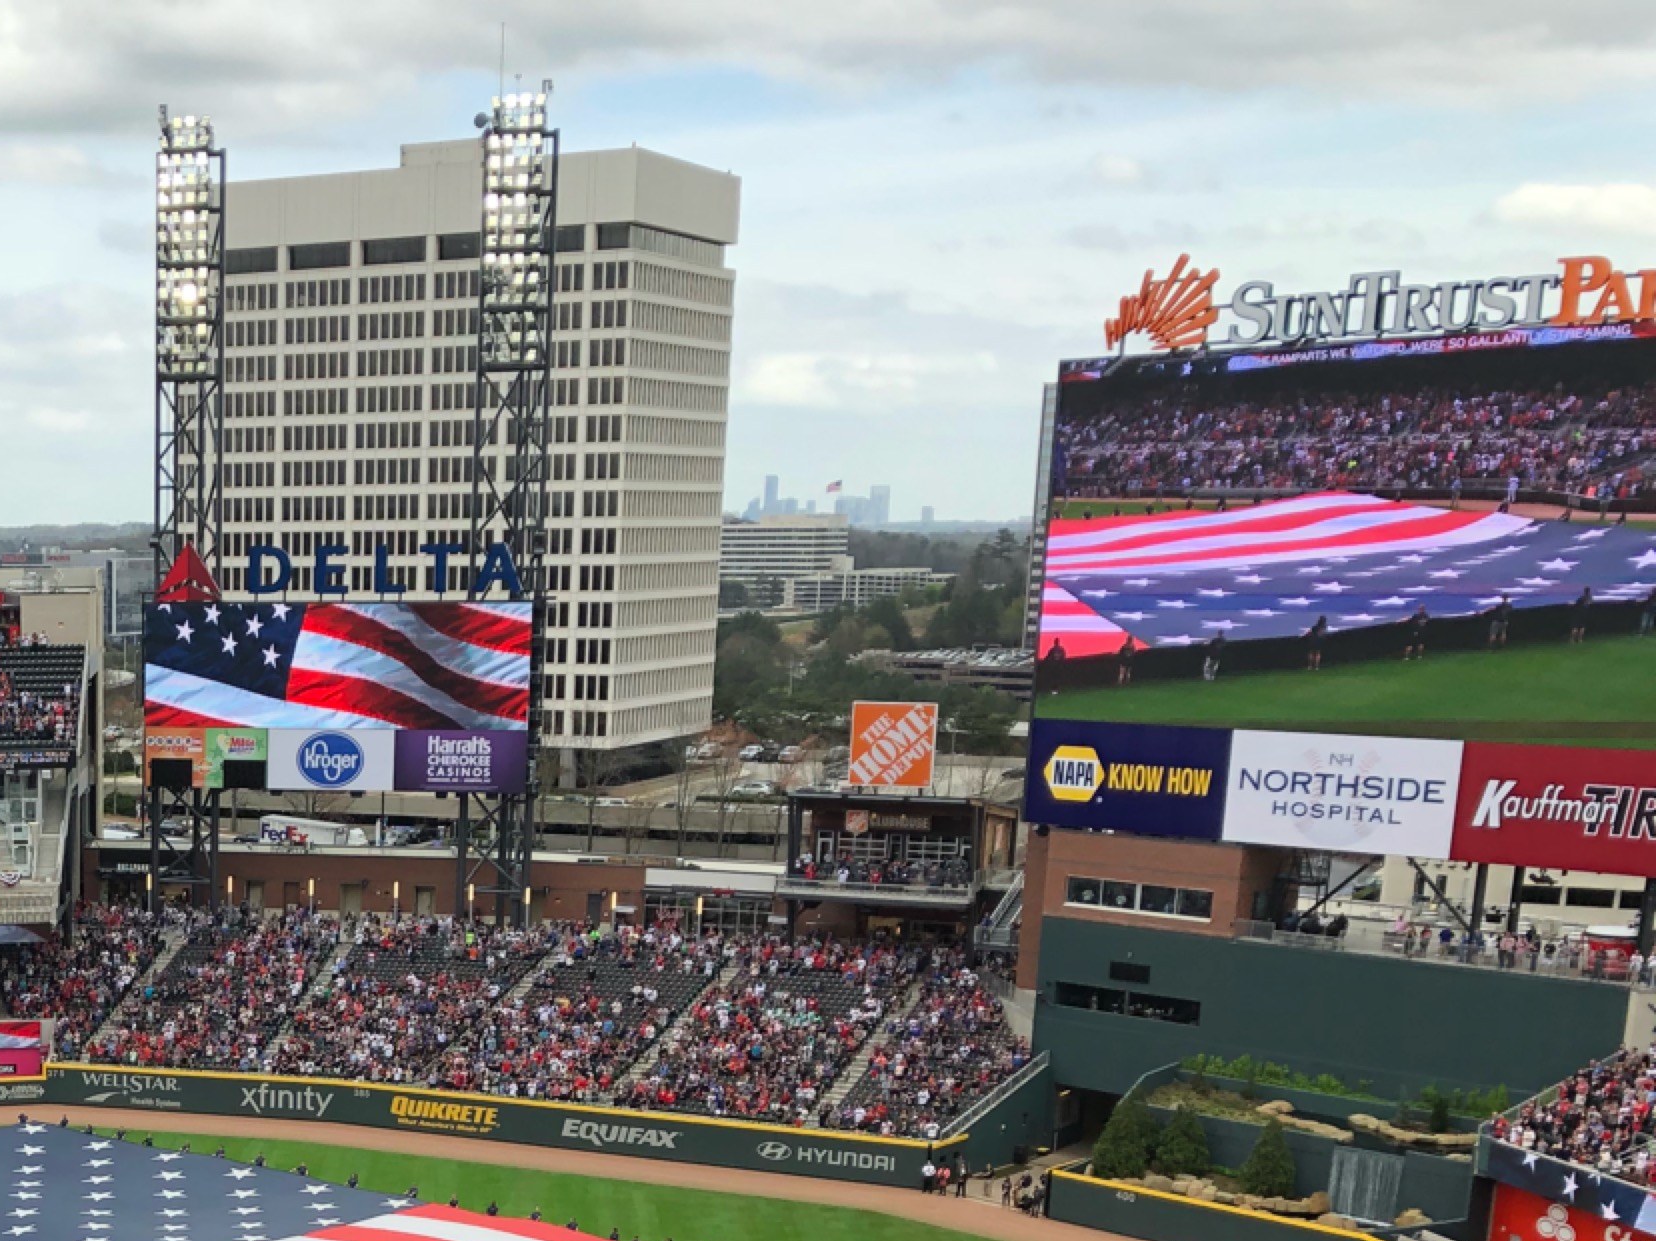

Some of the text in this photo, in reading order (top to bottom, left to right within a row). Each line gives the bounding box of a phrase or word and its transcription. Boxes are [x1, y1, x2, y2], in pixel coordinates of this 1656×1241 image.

[1447, 336, 1465, 349] SO
[248, 542, 522, 594] DELTA
[850, 704, 936, 784] HOME
[860, 712, 895, 744] THE
[305, 740, 359, 780] Kroger
[427, 755, 491, 767] CHEROKEE
[427, 767, 491, 777] CASINOS
[881, 735, 934, 784] DEPOT
[1052, 759, 1213, 797] NAPA KNOW HOW
[1239, 767, 1447, 803] NORTHSIDE
[1271, 801, 1403, 825] HOSPITAL
[1471, 779, 1621, 829] Kauffman
[261, 822, 309, 844] FedEx
[240, 1082, 334, 1117] xfinity
[390, 1095, 499, 1125] QUIKRETE
[561, 1117, 678, 1149] EQUIFAX
[797, 1145, 895, 1171] HYUNDAI
